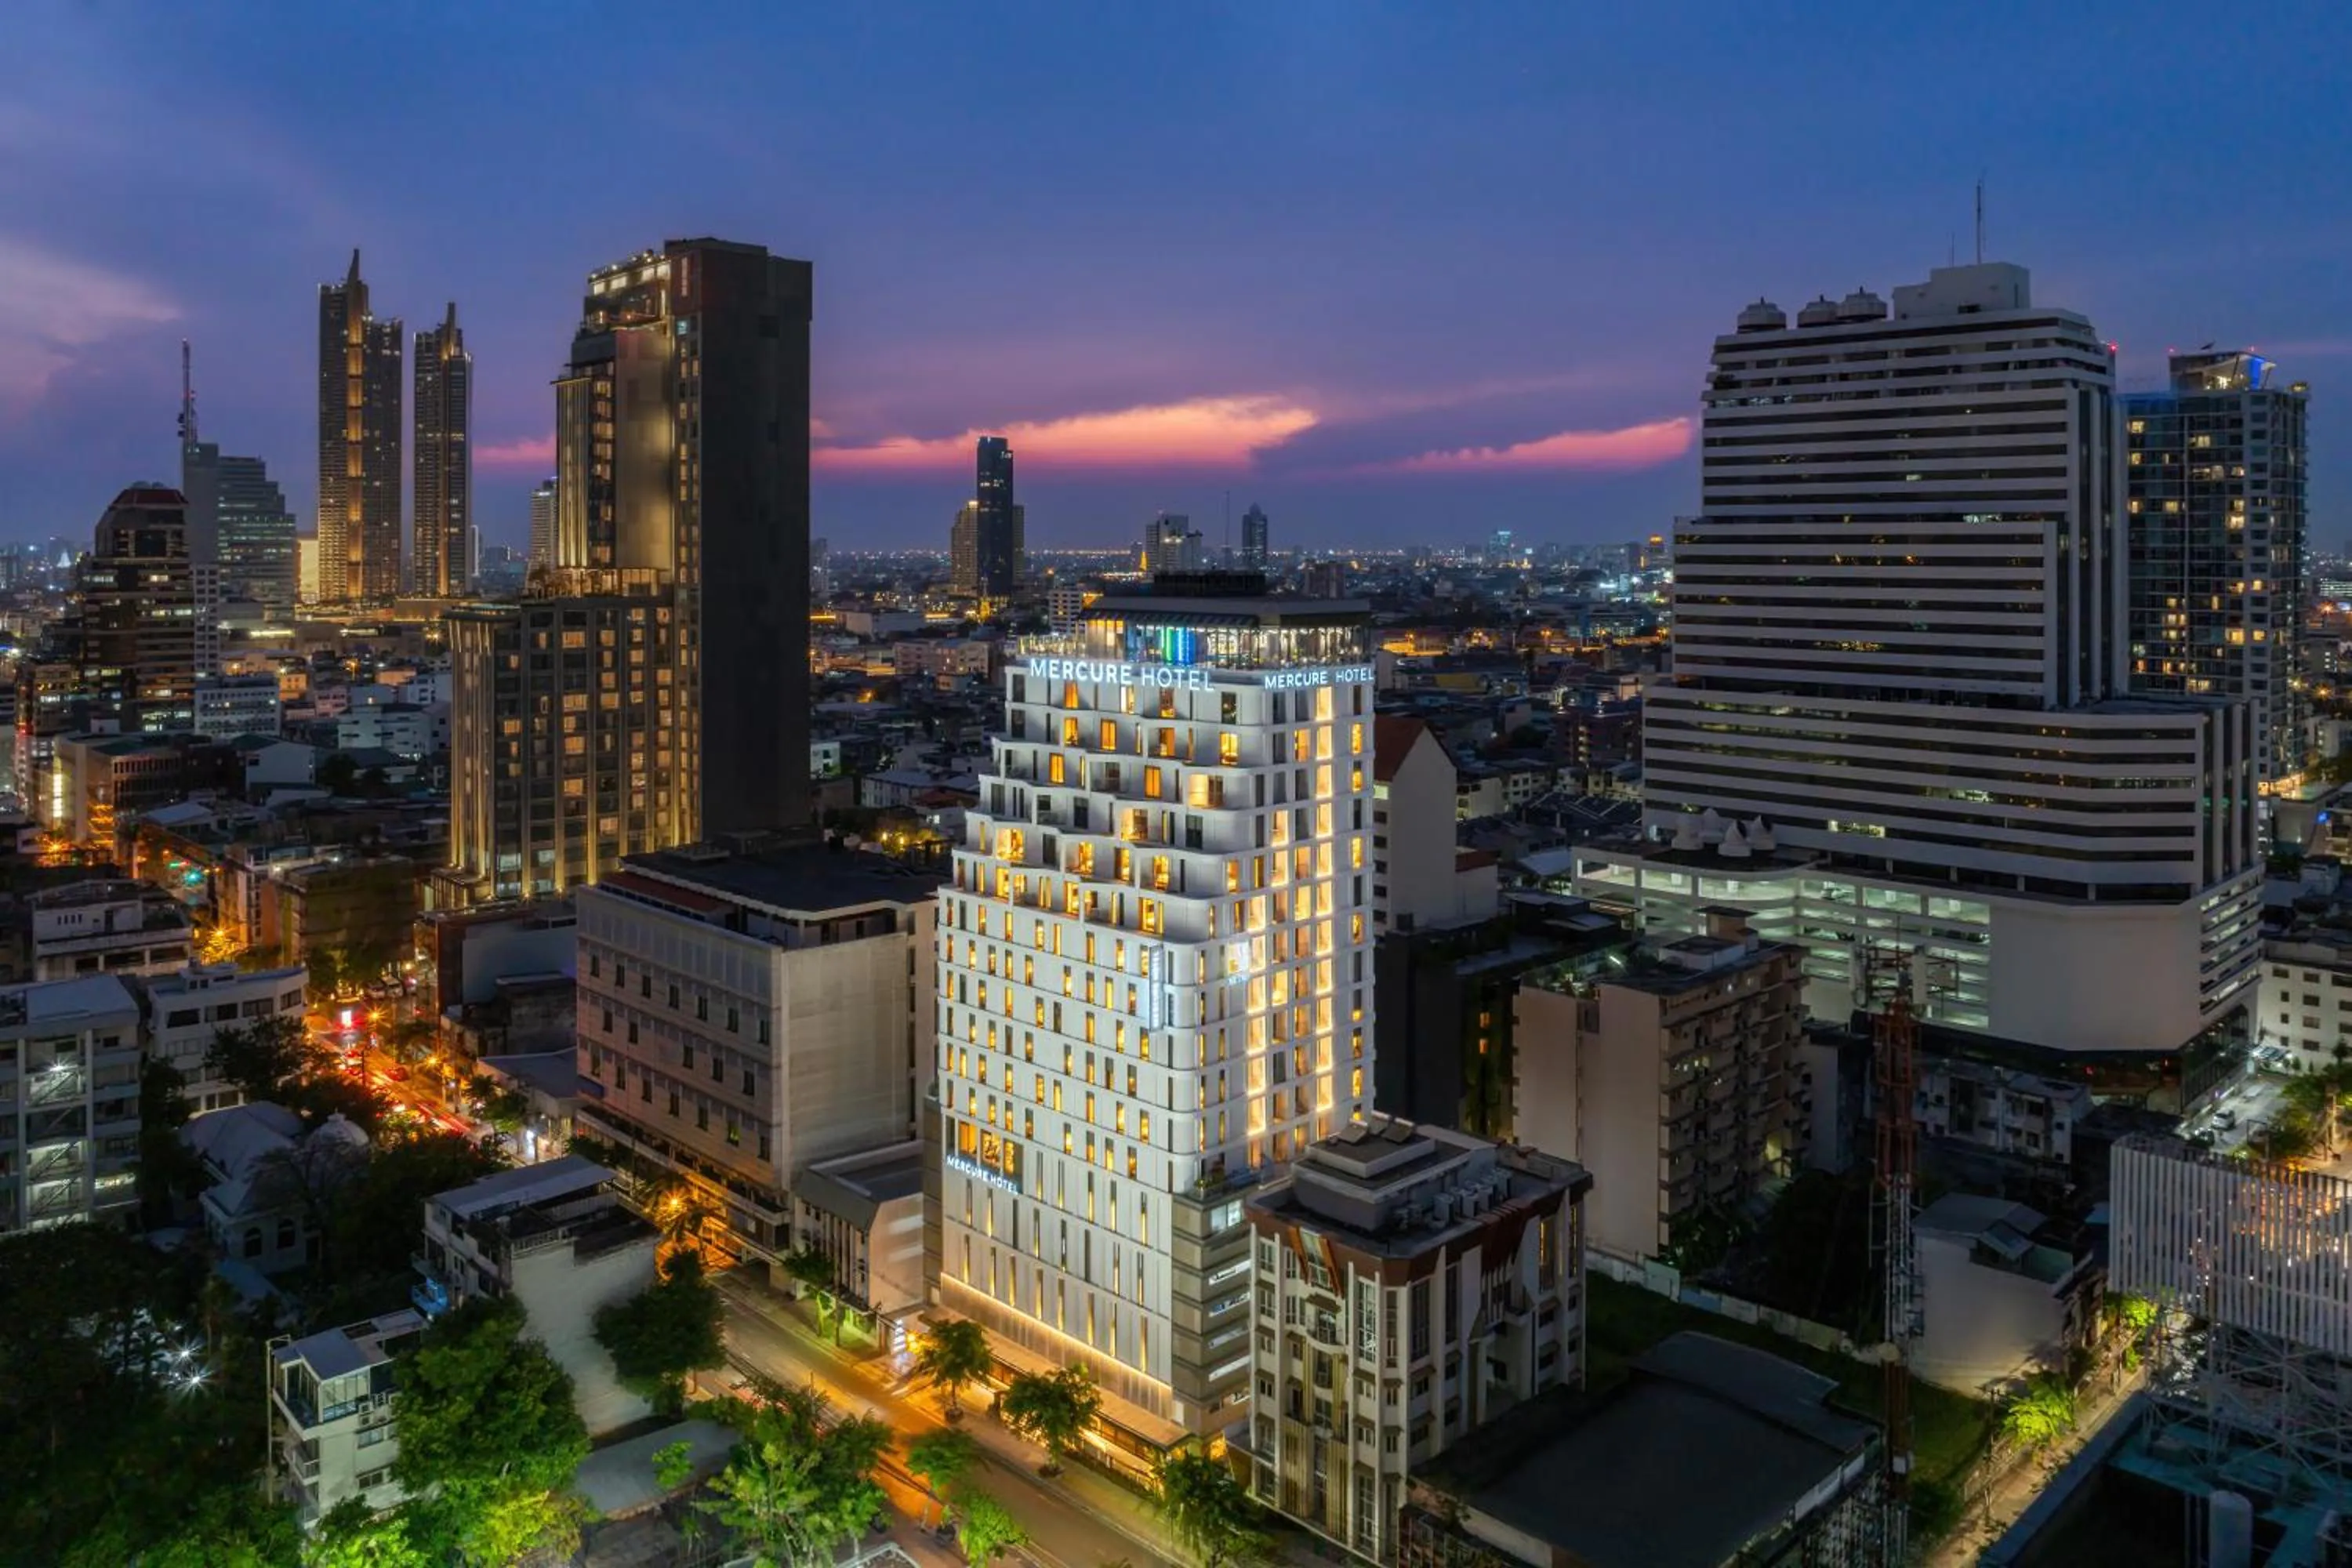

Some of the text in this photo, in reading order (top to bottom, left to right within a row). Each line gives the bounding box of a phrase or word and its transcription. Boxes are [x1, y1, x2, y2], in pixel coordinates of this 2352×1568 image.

[1030, 657, 1215, 691] MERCURE HOTEL
[1265, 666, 1374, 690] MERCURE HOTEL
[946, 1154, 1018, 1196] MERCURE HOTEL
